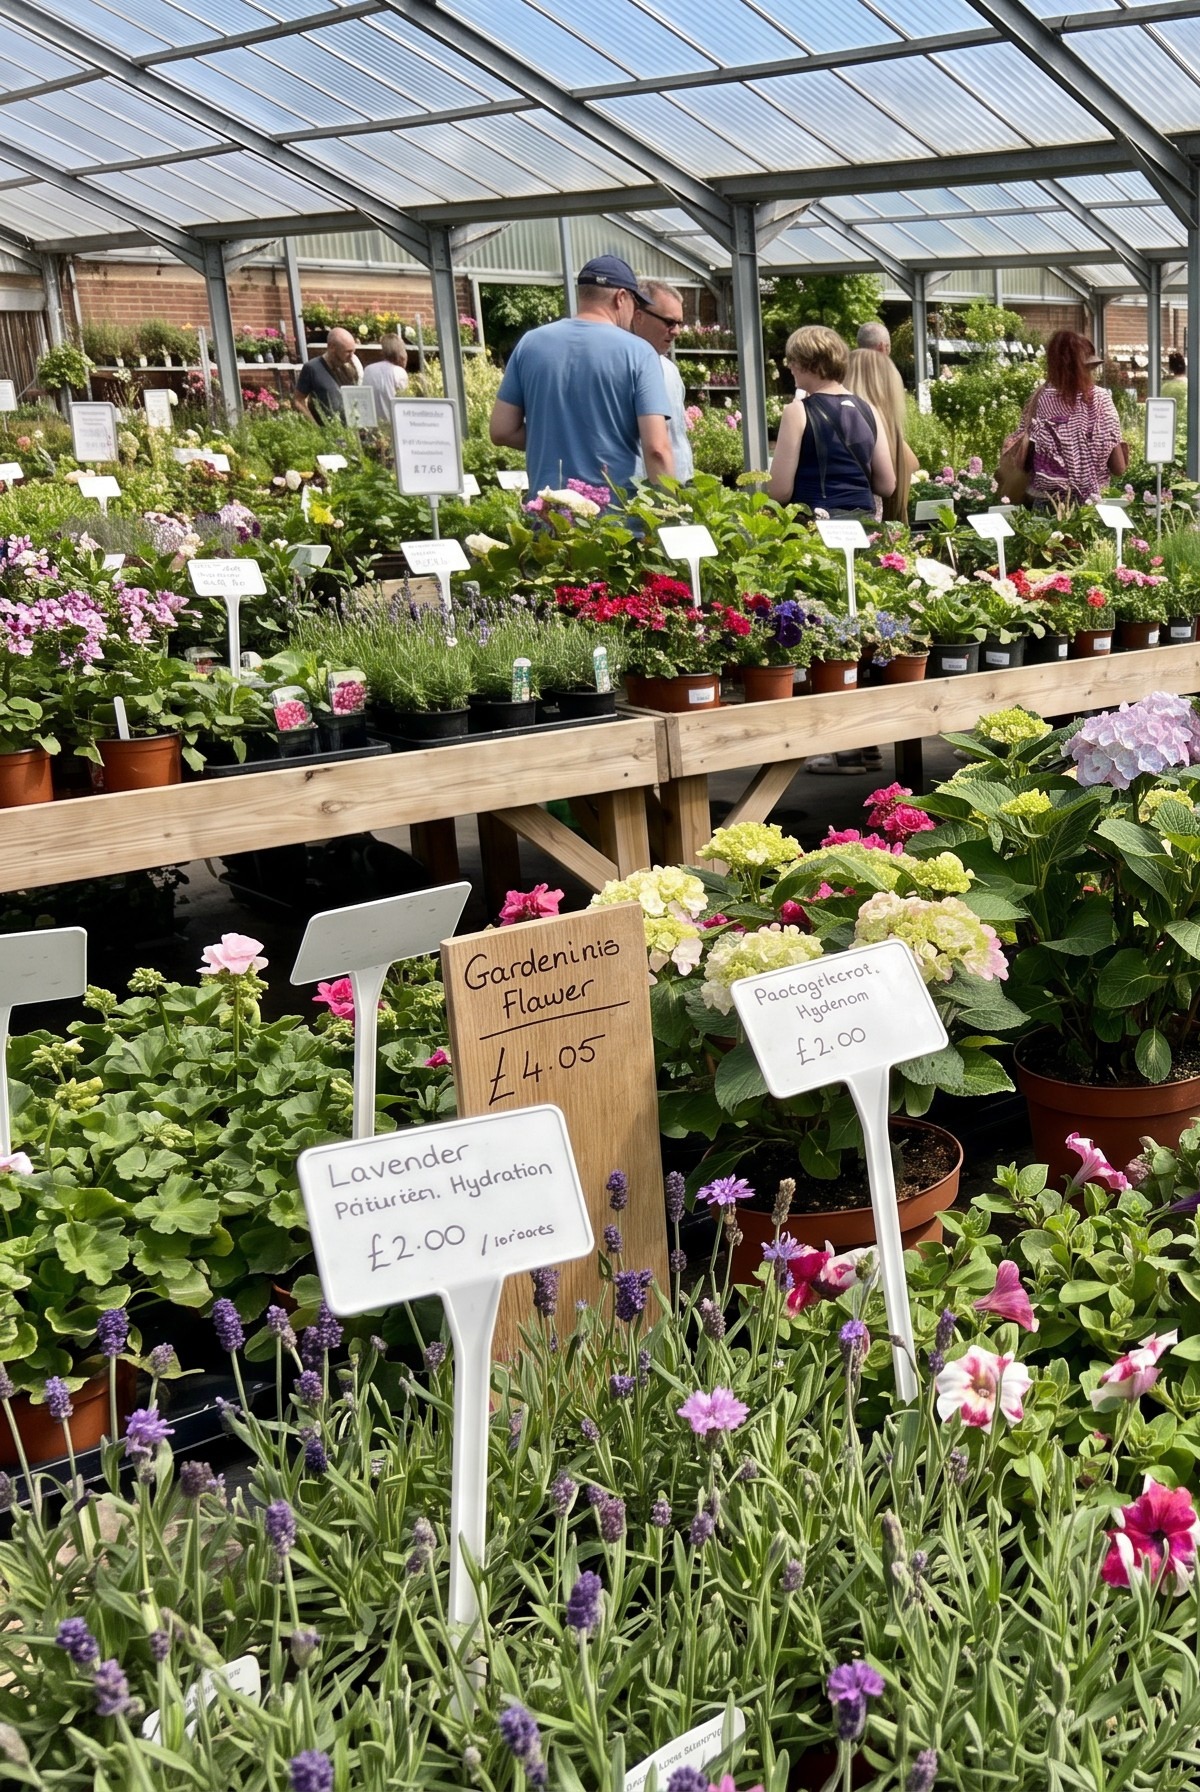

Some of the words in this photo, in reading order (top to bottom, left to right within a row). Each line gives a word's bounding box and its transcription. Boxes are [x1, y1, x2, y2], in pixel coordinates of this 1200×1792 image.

[796, 1027, 866, 1065] £2.00
[328, 1144, 469, 1188] Lavender
[450, 1161, 553, 1198] Hydration
[367, 1224, 466, 1272] £2.00
